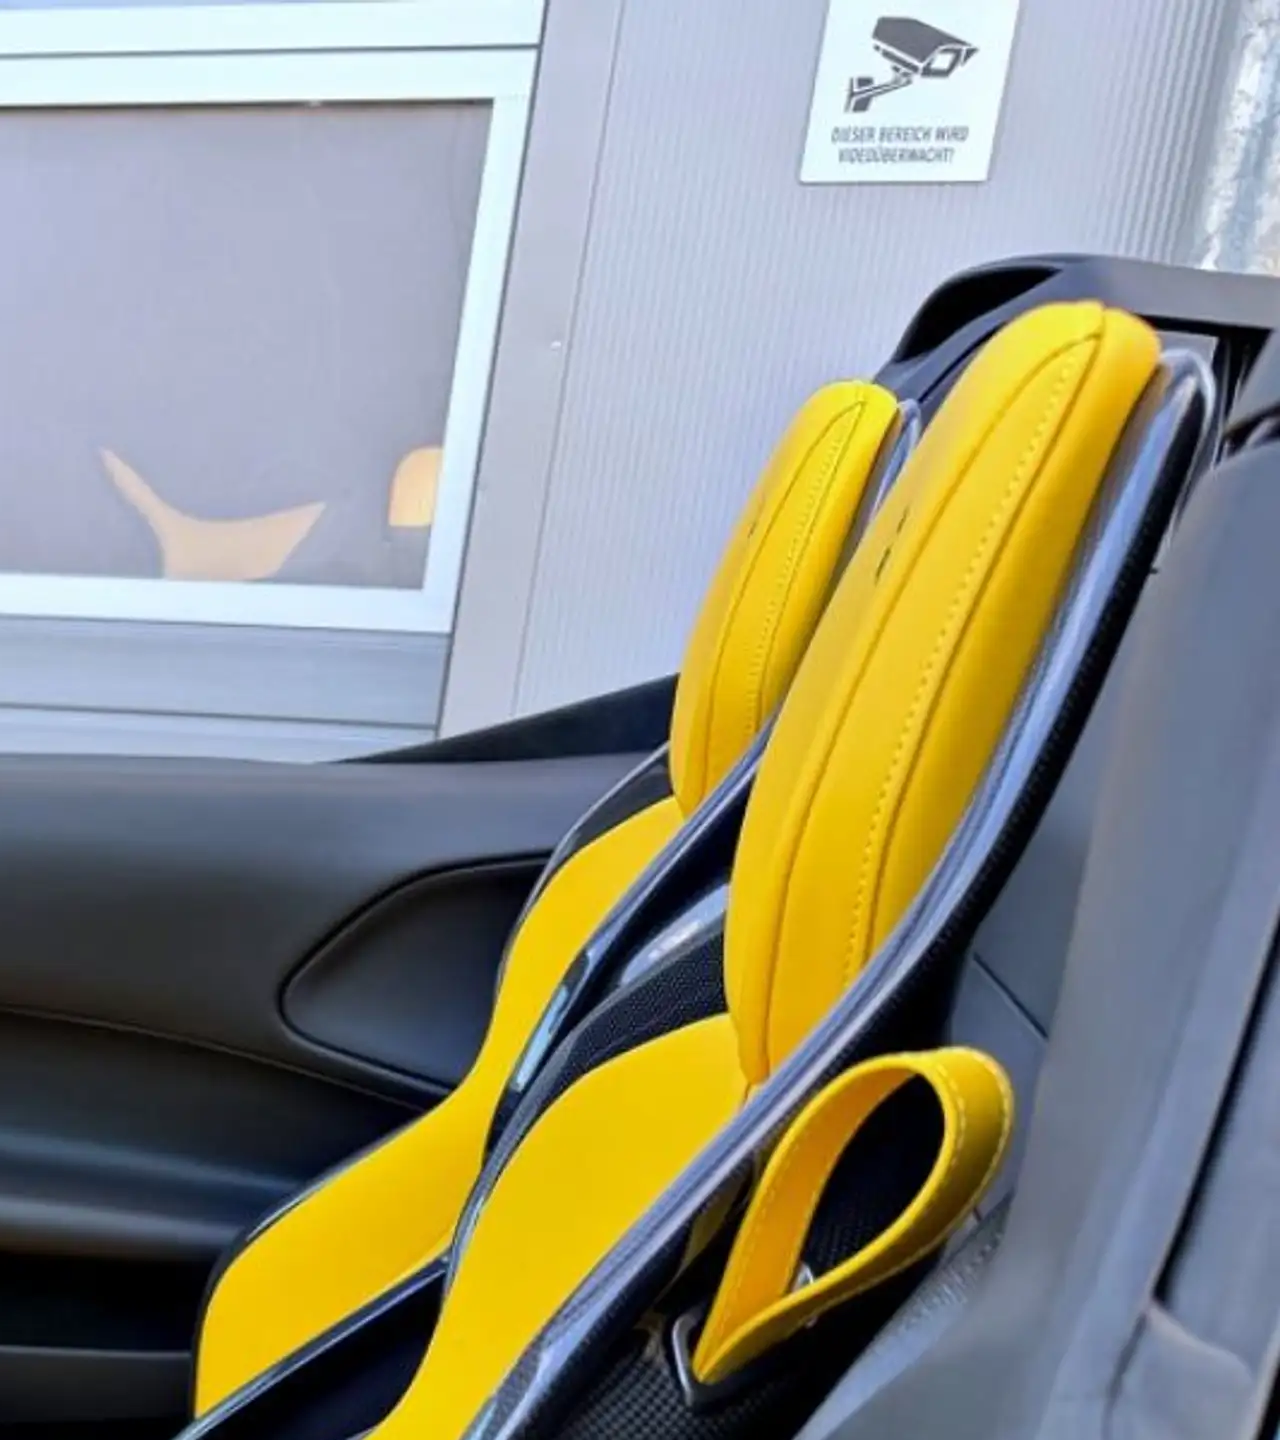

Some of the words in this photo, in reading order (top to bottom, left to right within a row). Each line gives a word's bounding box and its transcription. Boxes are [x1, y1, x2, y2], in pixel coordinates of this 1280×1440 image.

[831, 126, 875, 143] DIESER
[879, 126, 931, 142] BEREICH
[935, 125, 969, 142] WIRD
